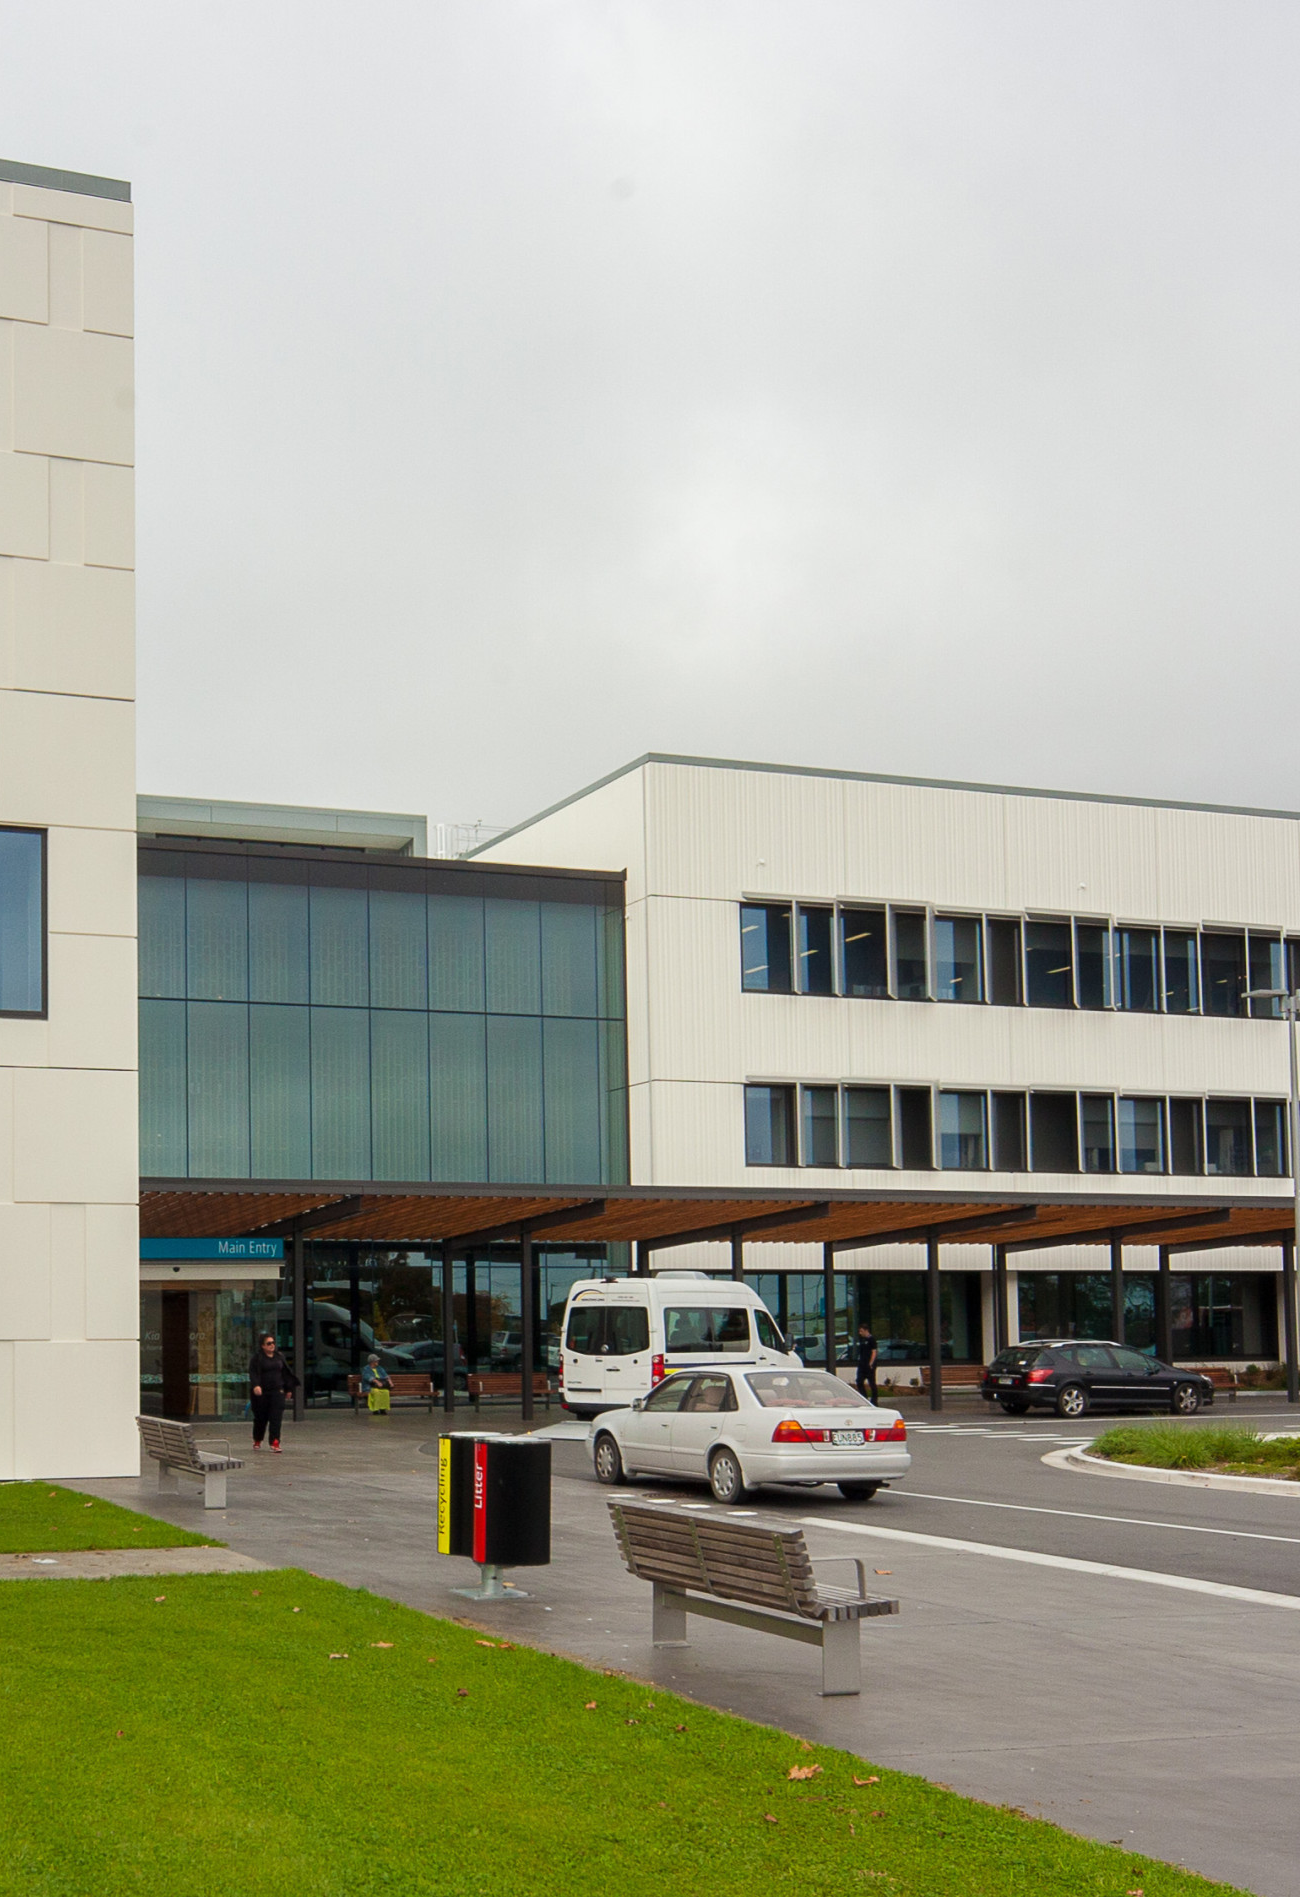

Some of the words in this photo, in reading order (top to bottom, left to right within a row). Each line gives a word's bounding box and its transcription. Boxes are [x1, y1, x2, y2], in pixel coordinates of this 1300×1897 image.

[218, 1240, 245, 1254] Main
[249, 1240, 277, 1257] Entry
[439, 1457, 448, 1535] Recycling
[475, 1463, 483, 1509] Litter
